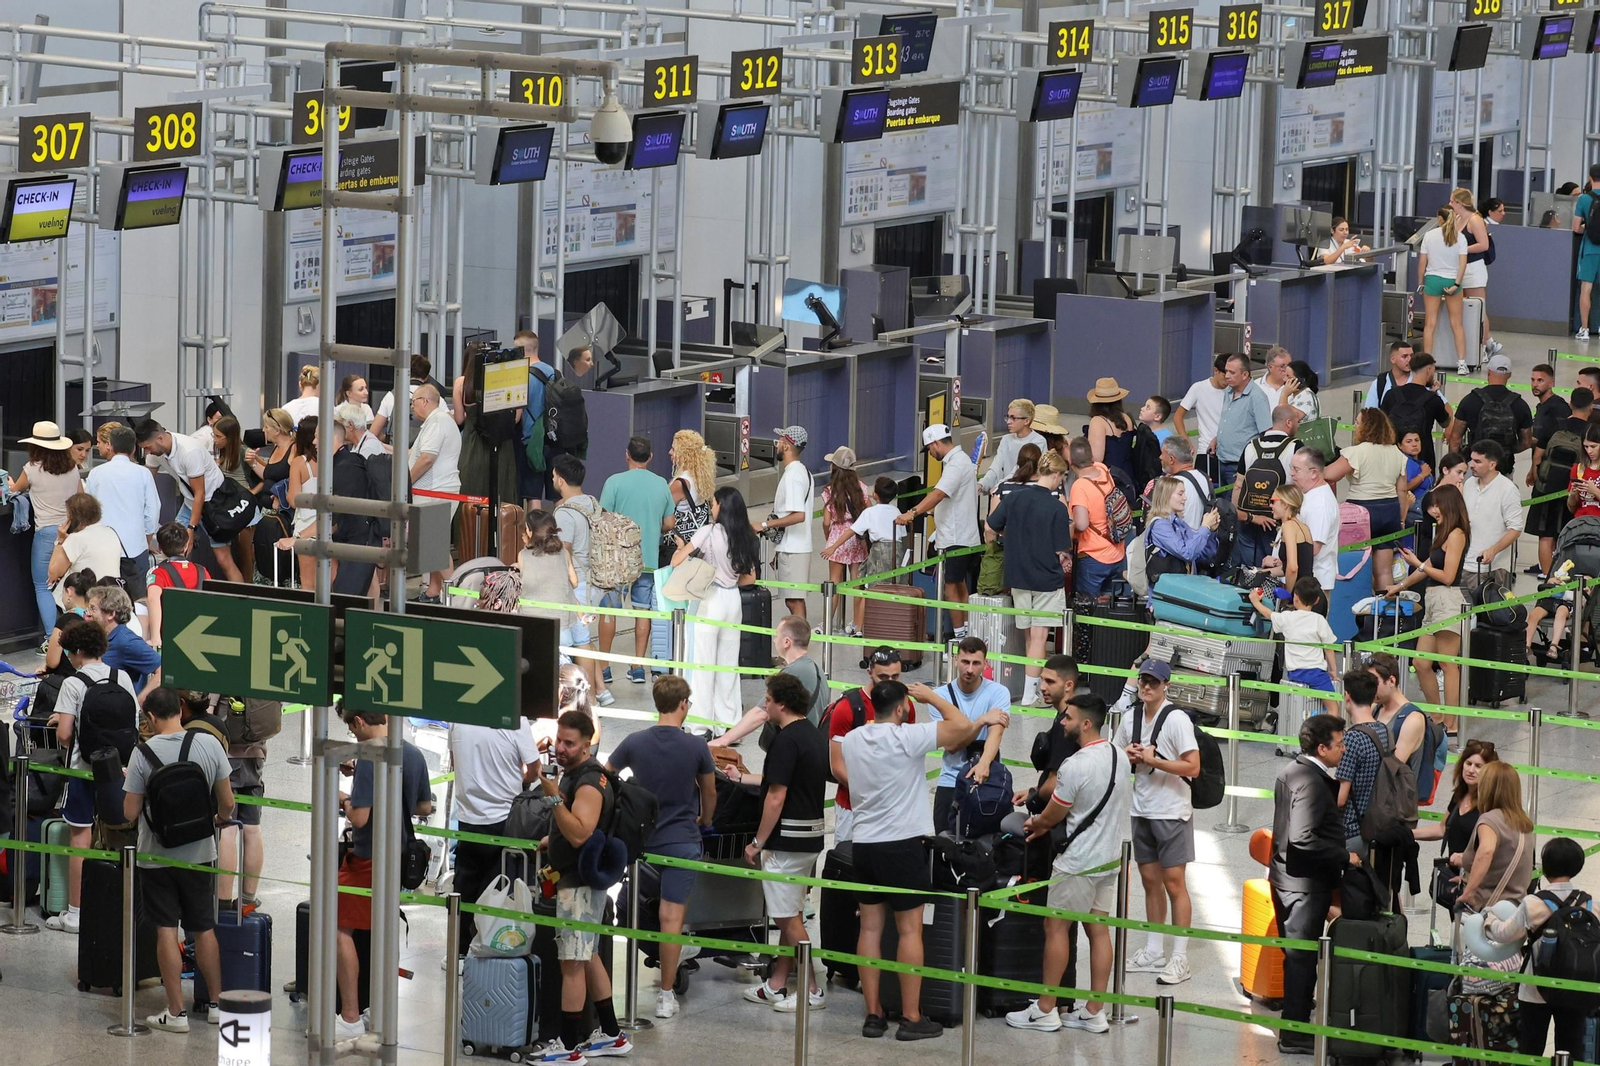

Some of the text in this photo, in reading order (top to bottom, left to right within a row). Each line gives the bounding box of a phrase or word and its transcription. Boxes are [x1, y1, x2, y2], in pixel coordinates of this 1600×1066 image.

[1226, 10, 1258, 41] 316
[1322, 1, 1352, 31] 317
[1056, 26, 1090, 58] 314
[1156, 15, 1189, 46] 315
[861, 42, 897, 77] 313
[653, 63, 692, 100] 311
[740, 55, 779, 91] 312
[521, 75, 562, 107] 310
[886, 107, 917, 117] Boarding gates
[886, 117, 907, 128] Puertas
[907, 115, 914, 126] de
[915, 114, 941, 125] embarque
[31, 122, 85, 163] 307
[146, 111, 196, 152] 308
[360, 154, 376, 164] Gates
[356, 166, 371, 178] gates
[359, 177, 368, 188] de
[131, 178, 172, 193] CHECK-IN
[17, 190, 60, 206] CHECK-IN
[151, 203, 178, 217] vueling
[39, 216, 65, 230] vueling
[227, 499, 250, 518] FILA
